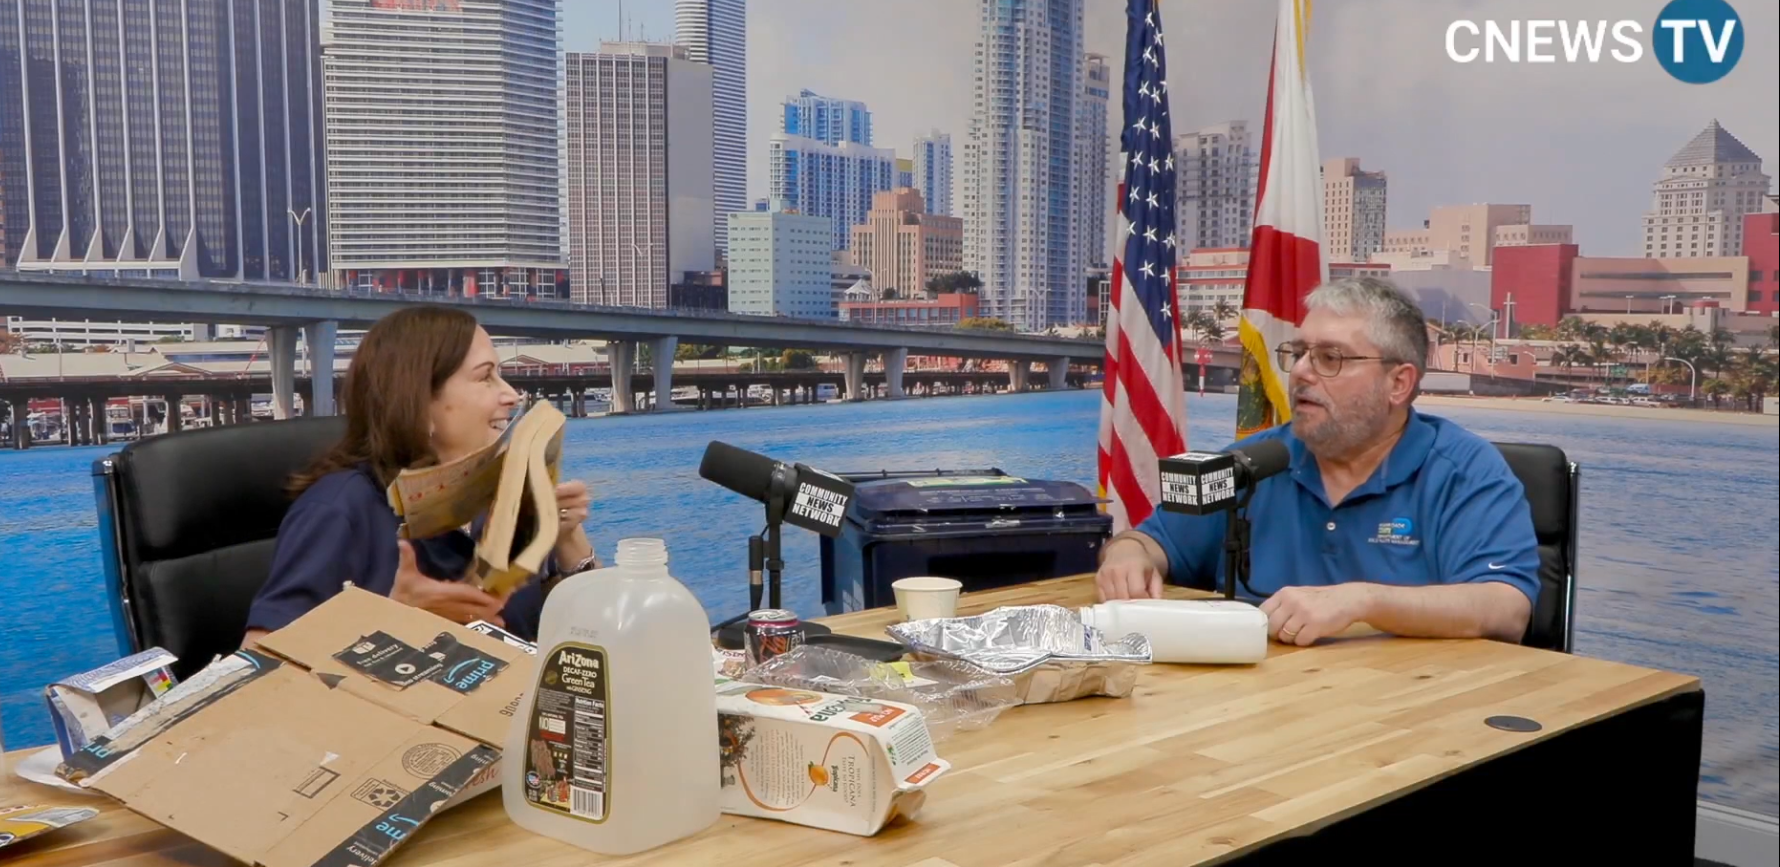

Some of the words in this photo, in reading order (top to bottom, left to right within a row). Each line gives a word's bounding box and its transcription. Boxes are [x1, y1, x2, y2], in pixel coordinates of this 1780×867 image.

[1161, 471, 1196, 486] COMMUNITY
[1201, 467, 1234, 485] COMMUNITY
[799, 482, 848, 506] COMMUNITY
[1169, 483, 1190, 494] NEWS
[1209, 480, 1228, 492] NEWS
[806, 496, 834, 513] NEWS
[1162, 492, 1198, 506] NETWORK
[1202, 488, 1235, 505] NETWORK
[792, 504, 840, 528] NETWORK
[558, 650, 599, 669] AriZona
[455, 659, 495, 690] prime
[561, 673, 583, 686] Green
[582, 676, 595, 688] Tea
[848, 755, 857, 808] TROPICANA
